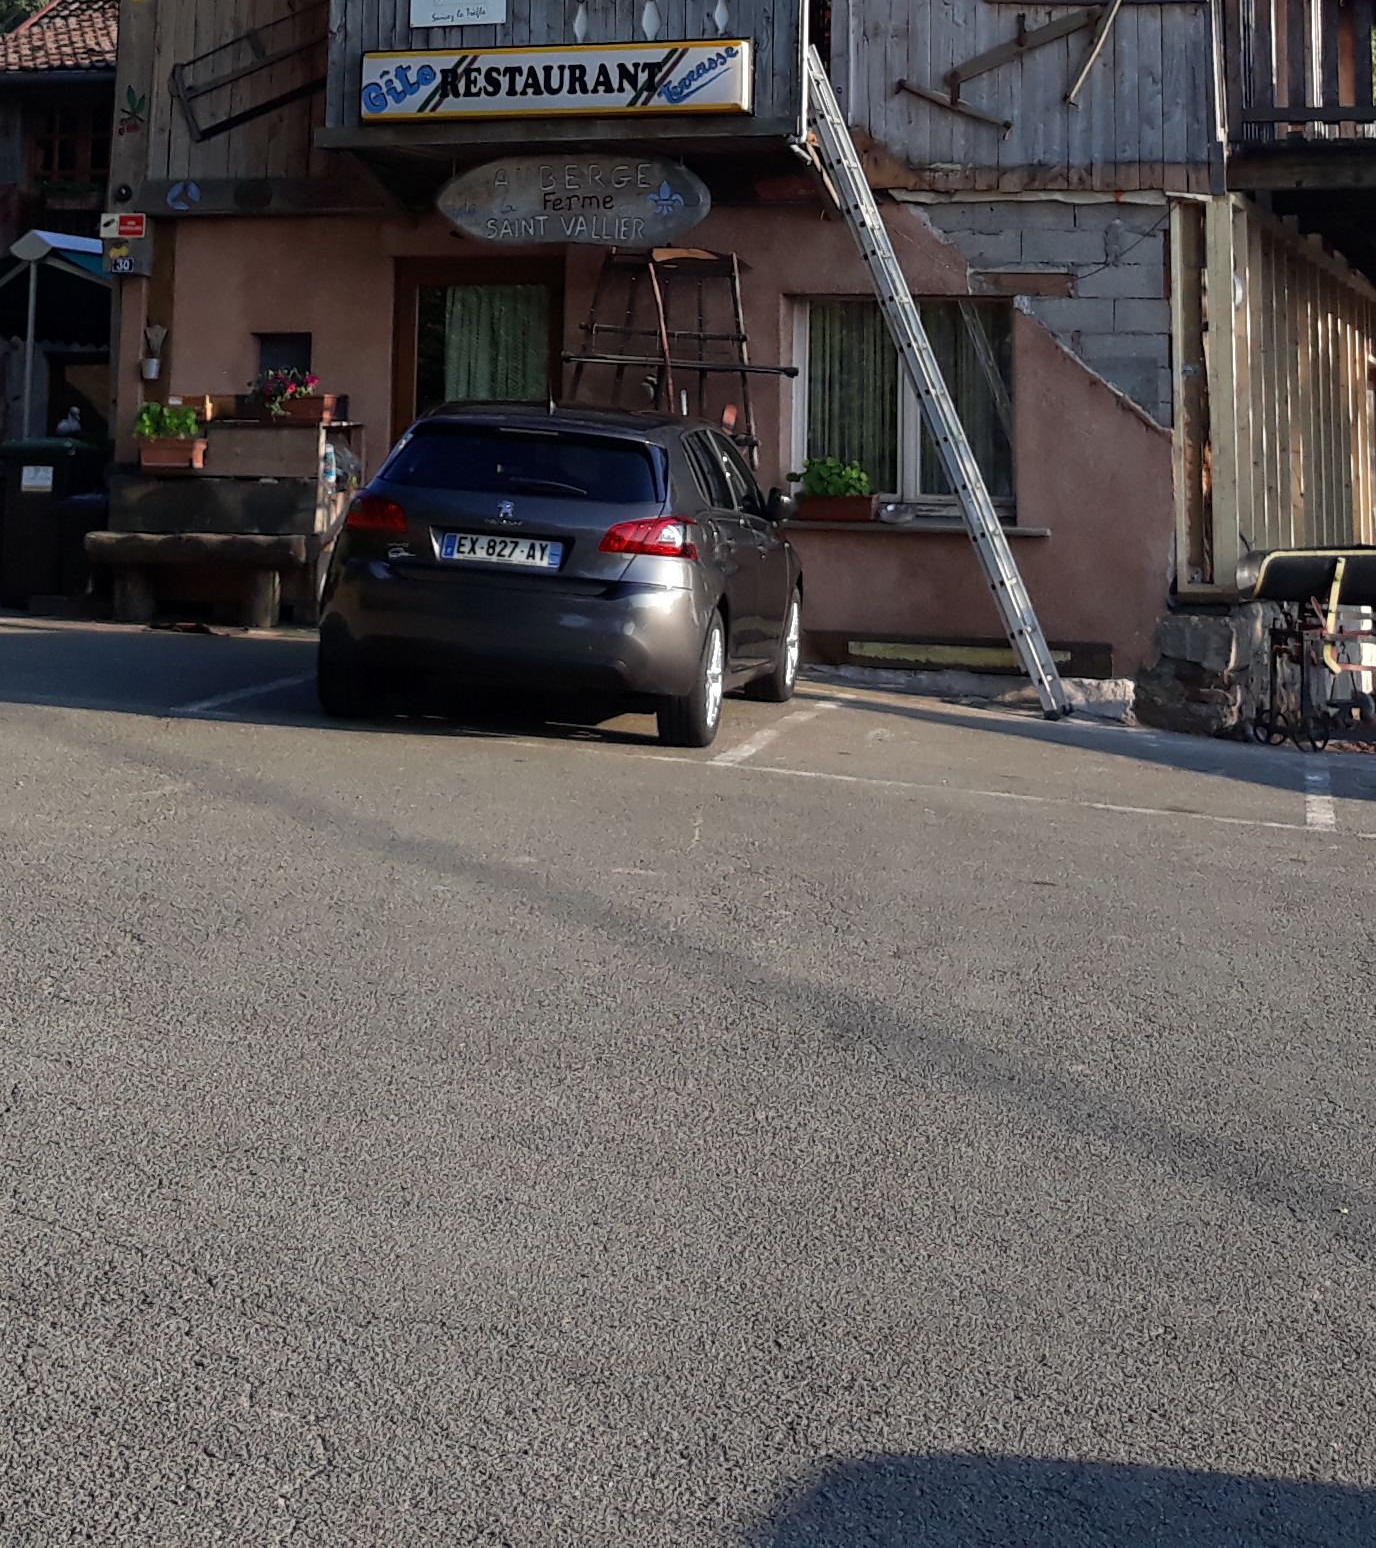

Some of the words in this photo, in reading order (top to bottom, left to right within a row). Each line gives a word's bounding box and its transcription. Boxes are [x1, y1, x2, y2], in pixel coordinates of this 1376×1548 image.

[439, 61, 662, 100] RESTAURANT
[543, 191, 614, 212] Ferme
[486, 215, 549, 239] SAINT
[560, 215, 646, 241] VALLIER
[116, 258, 130, 271] 30
[456, 536, 549, 562] EX-827-AY
